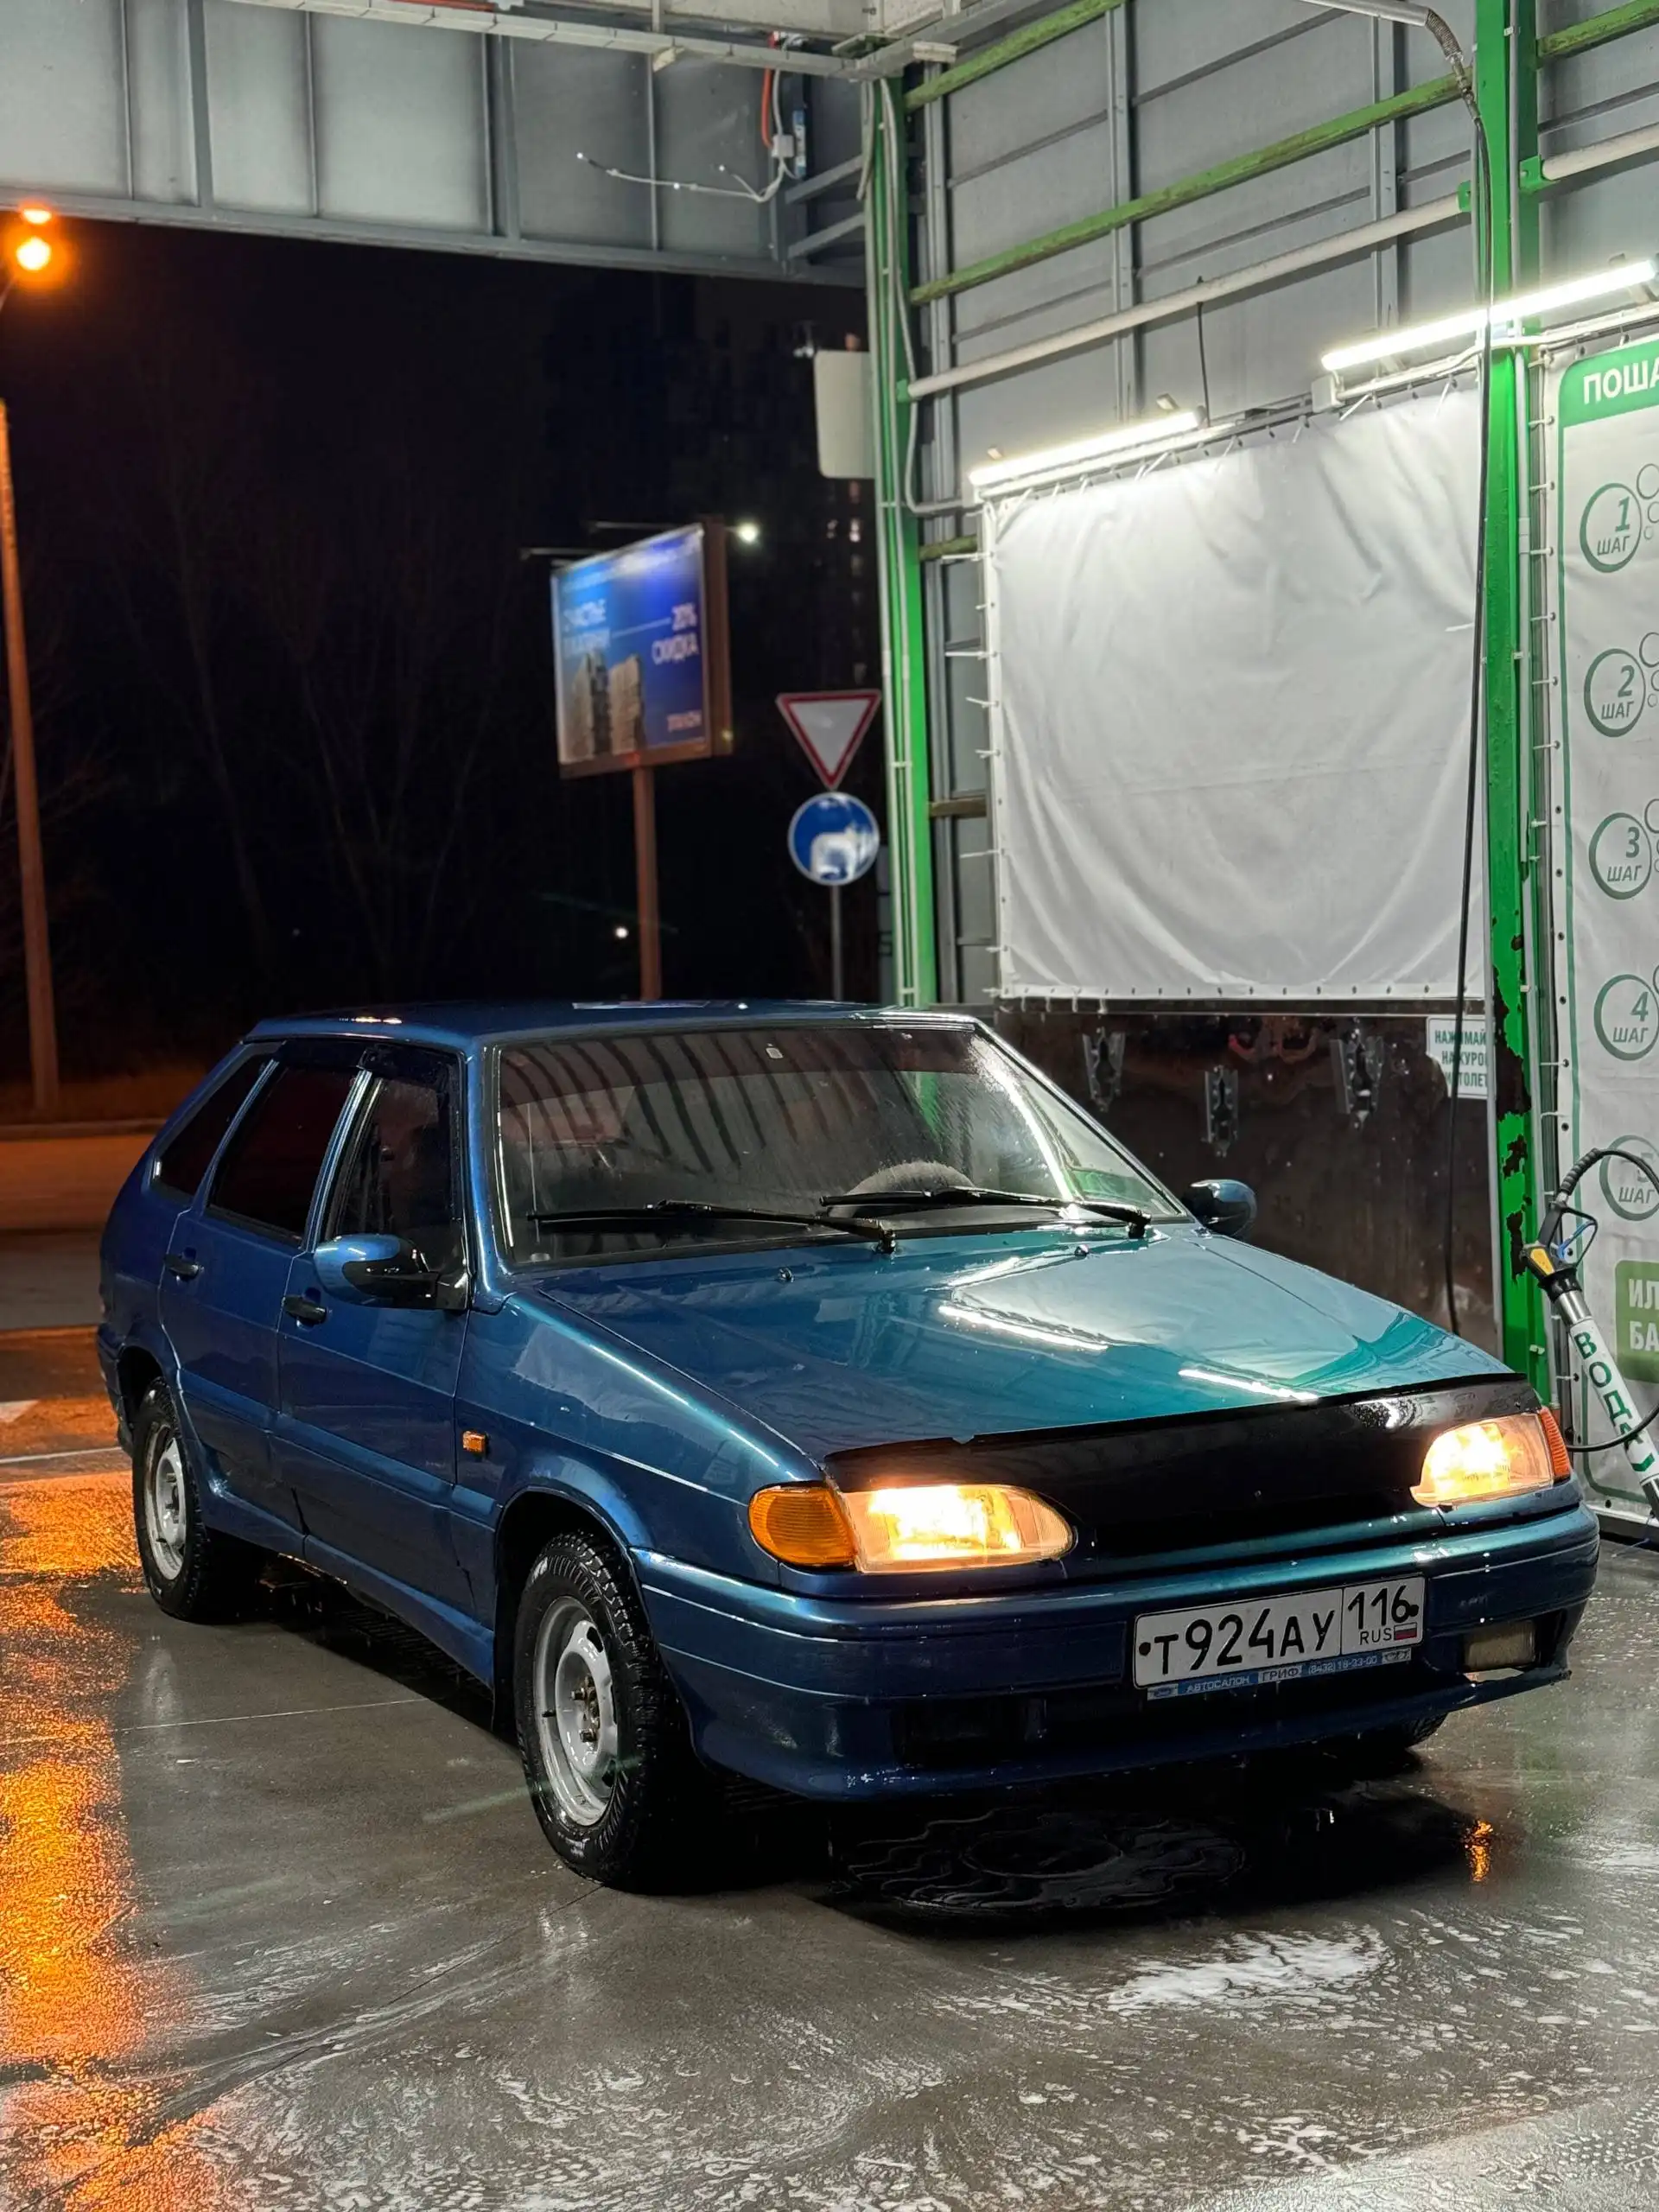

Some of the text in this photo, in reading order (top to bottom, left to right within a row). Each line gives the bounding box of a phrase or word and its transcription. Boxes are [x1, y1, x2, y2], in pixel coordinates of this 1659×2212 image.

[1615, 495, 1631, 533] 1
[1597, 535, 1631, 556] ШАГ
[1617, 664, 1636, 698] 2
[1601, 701, 1635, 721] ШАГ
[1625, 826, 1641, 859] 3
[1606, 864, 1643, 882] ШАГ
[1630, 990, 1649, 1023] 4
[1612, 1027, 1649, 1044] ШАГ
[1618, 1186, 1655, 1205] ШАГ
[1573, 1332, 1643, 1451] ВОДА
[1347, 1585, 1410, 1630] 116
[1359, 1627, 1392, 1645] RUS
[1185, 1675, 1250, 1694] АВТОСАЛОН
[1262, 1667, 1300, 1682] ГРИФ
